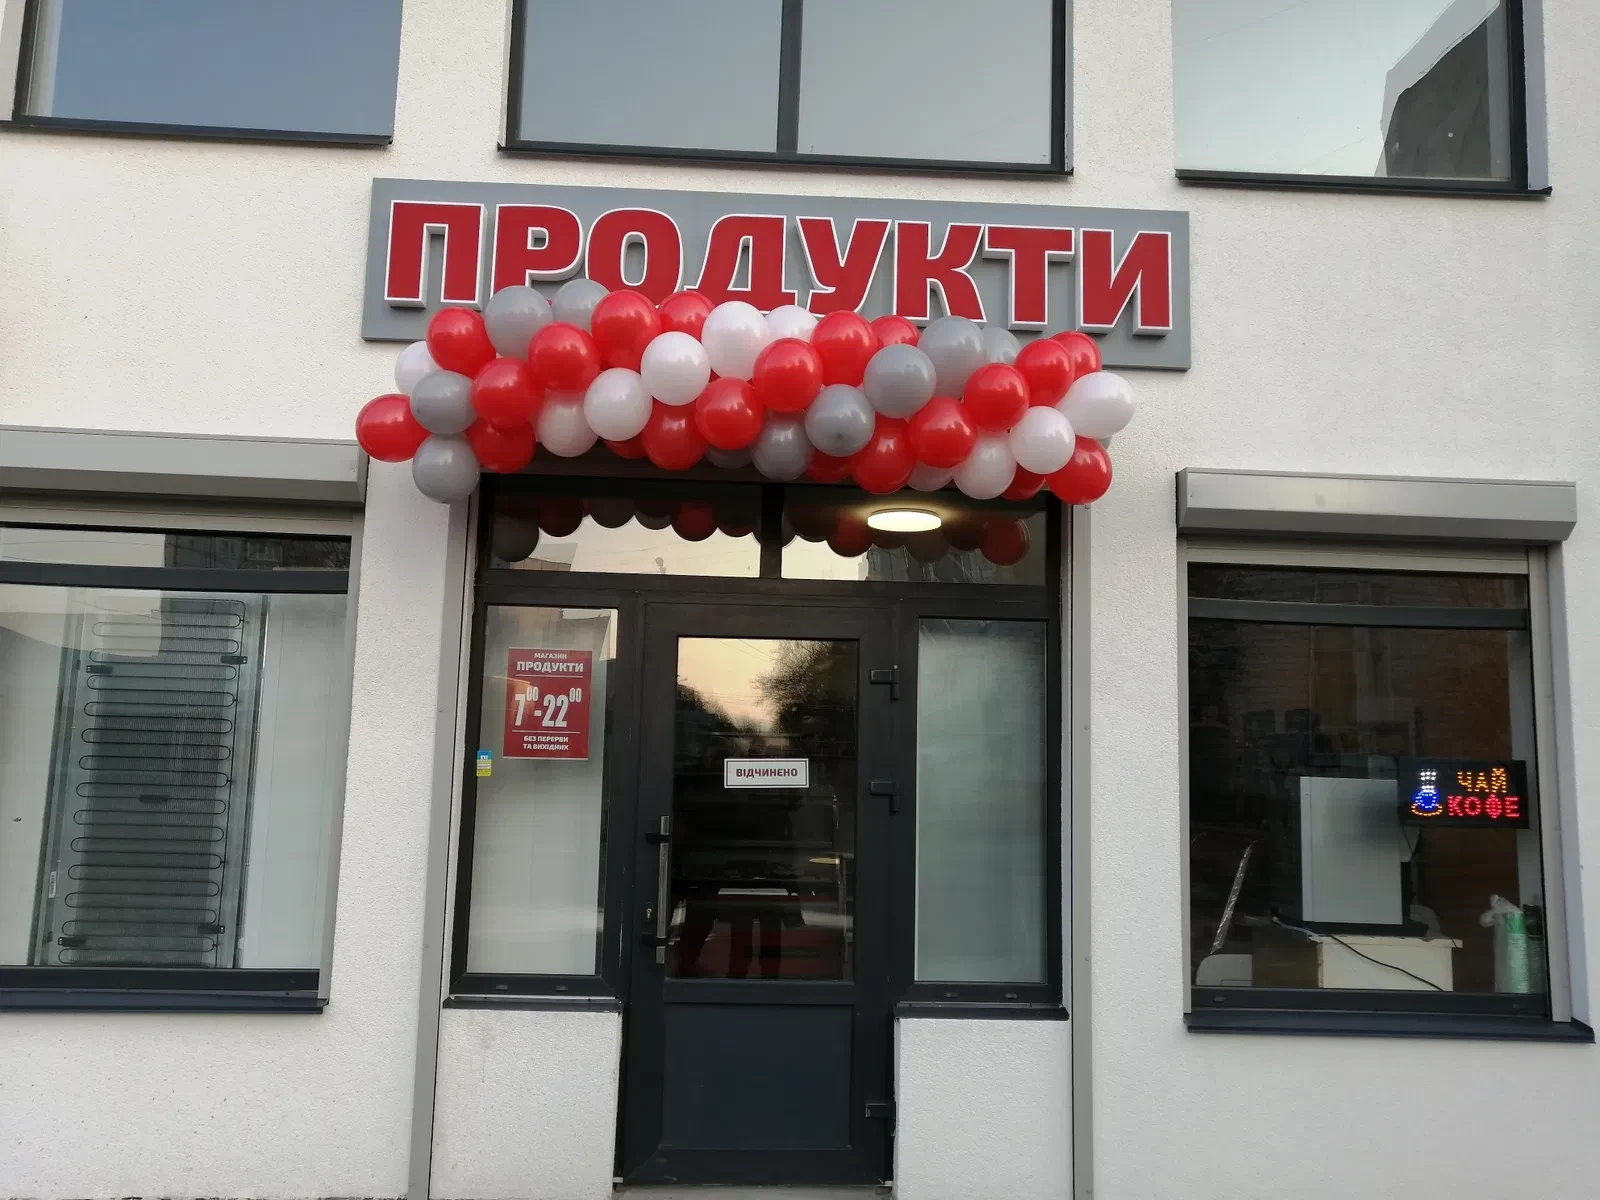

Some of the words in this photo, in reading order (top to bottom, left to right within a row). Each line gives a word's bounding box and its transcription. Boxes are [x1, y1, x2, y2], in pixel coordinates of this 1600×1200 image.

[384, 199, 1173, 334] ПРОДУКТИ
[534, 652, 567, 660] МАГАЗИН
[516, 661, 584, 673] ПРОДУКТИ
[537, 735, 569, 743] ПЕРЕРВИ
[532, 743, 569, 751] ВИХІДНИХ
[736, 768, 798, 778] ВІДЧИНЕНО
[1457, 768, 1507, 793] ЧАЙ
[1447, 793, 1520, 819] КОФЕ
